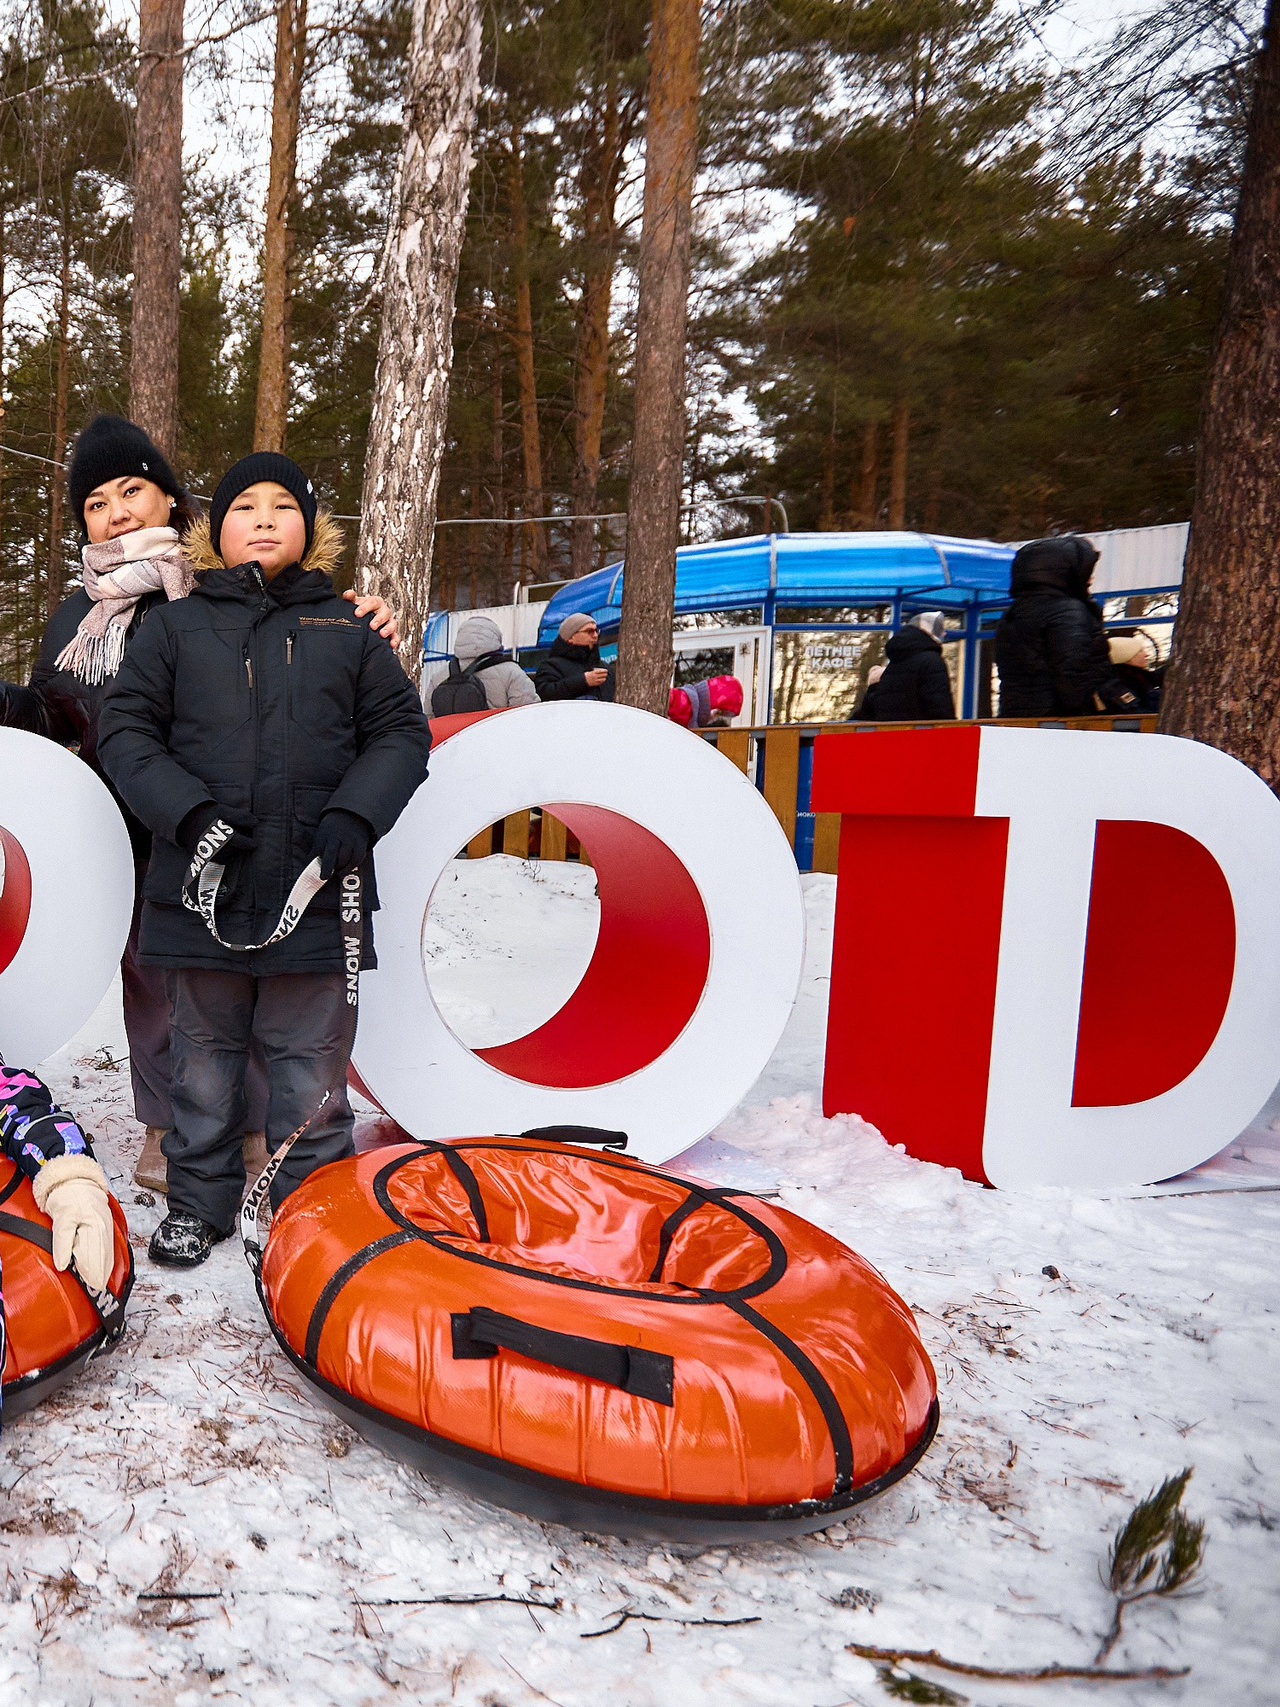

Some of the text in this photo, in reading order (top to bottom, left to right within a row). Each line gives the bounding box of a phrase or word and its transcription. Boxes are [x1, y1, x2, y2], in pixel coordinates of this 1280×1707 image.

[811, 657, 854, 669] КАФЕ
[189, 819, 235, 878] SNOW
[340, 866, 361, 1007] SNOW SHO
